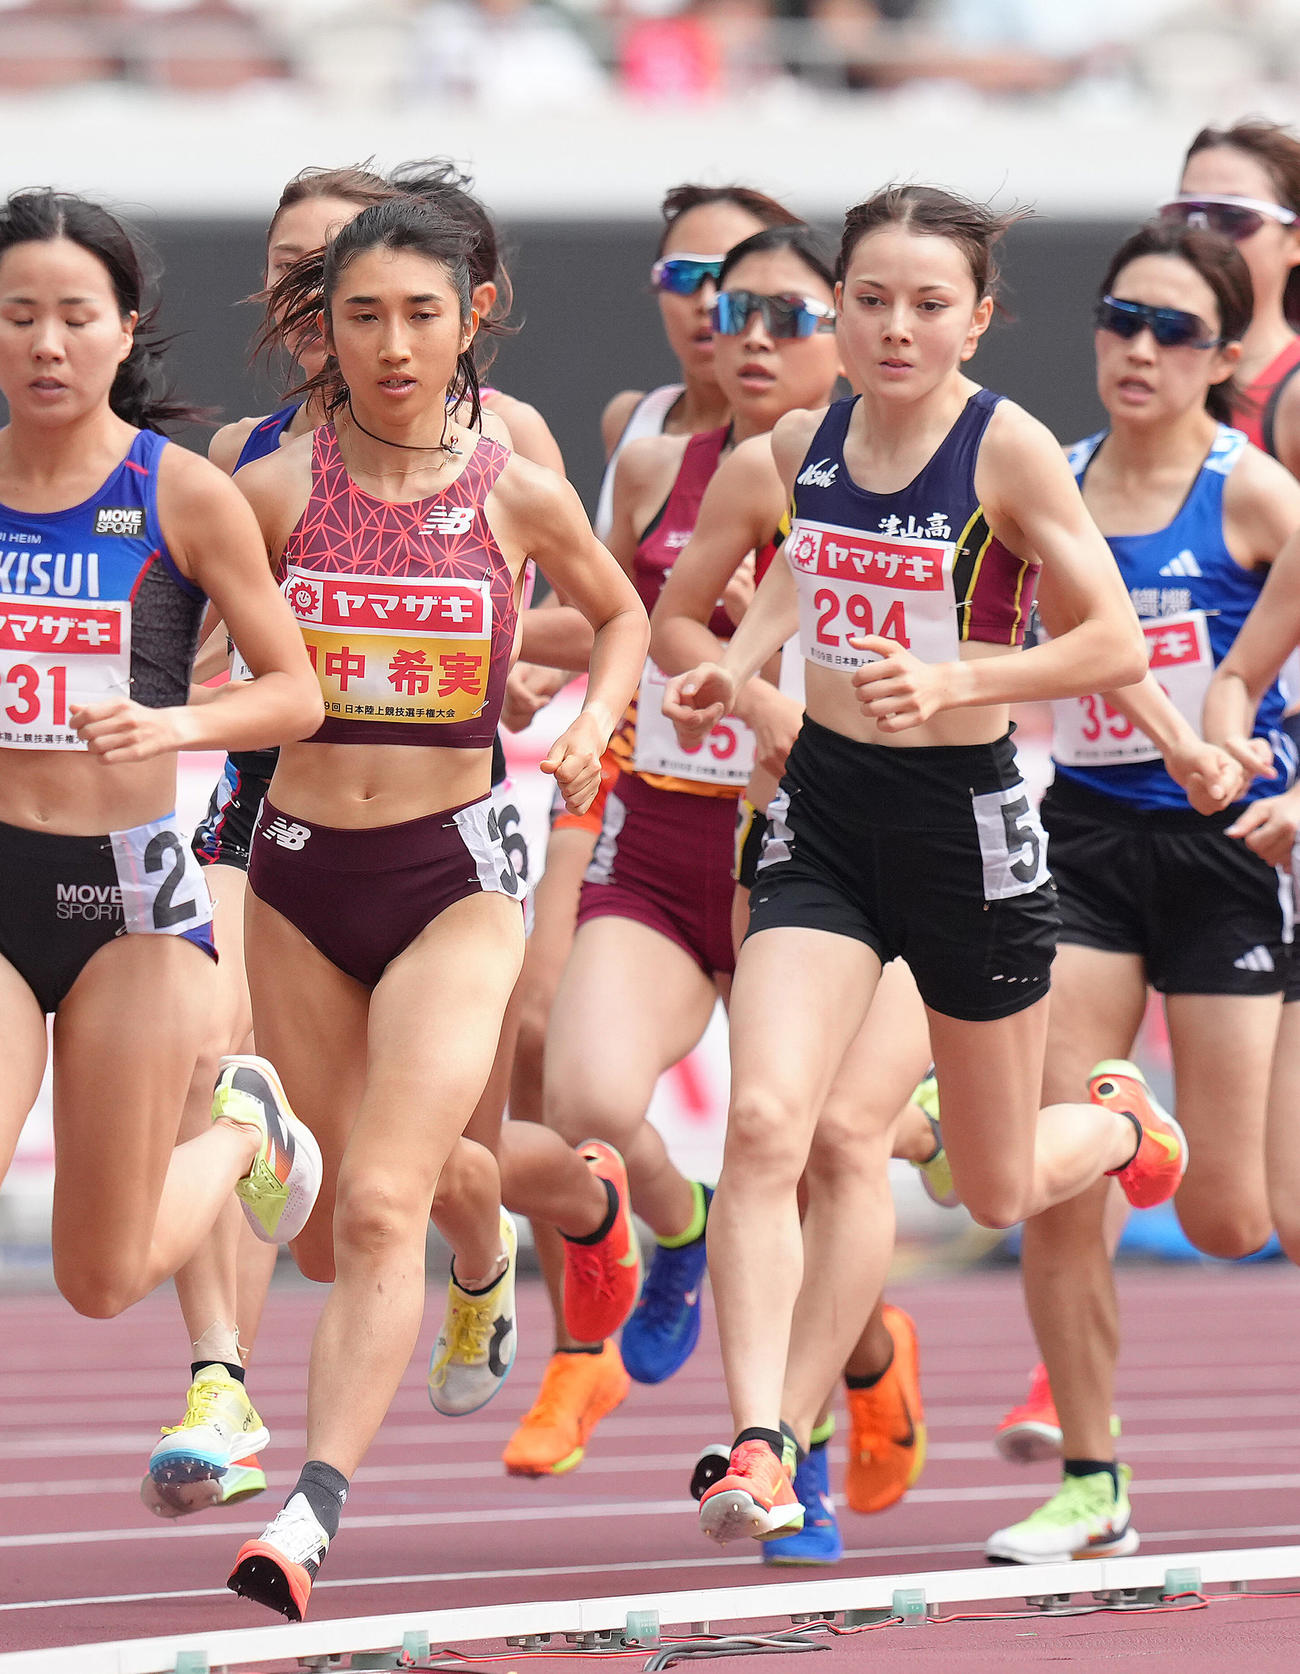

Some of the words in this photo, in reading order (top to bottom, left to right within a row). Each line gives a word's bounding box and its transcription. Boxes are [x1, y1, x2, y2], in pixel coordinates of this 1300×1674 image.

[96, 521, 141, 535] SPORT
[98, 509, 143, 524] MOVE
[878, 512, 952, 540] 津山高
[9, 533, 42, 544] HEIM
[825, 542, 934, 583] ヤマザキ
[332, 590, 473, 623] ヤマザキ
[814, 588, 911, 650] 294
[0, 614, 111, 646] マザキ
[387, 648, 482, 698] 希実
[0, 664, 67, 726] 31
[345, 704, 456, 718] 日本陸上競技選手権大会
[1001, 794, 1039, 883] 5
[144, 831, 196, 929] 2
[57, 902, 123, 920] SPORT
